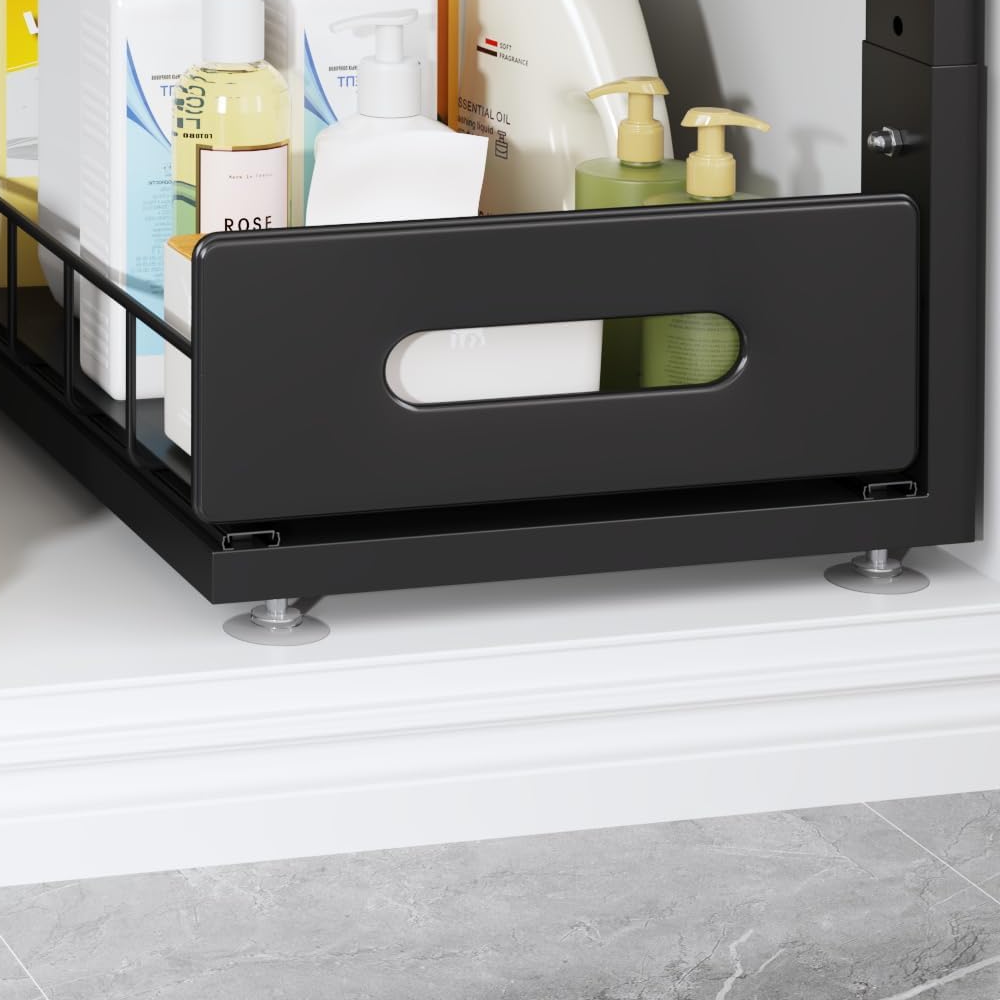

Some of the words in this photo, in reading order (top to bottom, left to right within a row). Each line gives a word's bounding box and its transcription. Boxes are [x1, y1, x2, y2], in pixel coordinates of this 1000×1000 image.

[499, 42, 512, 51] SOFT
[499, 52, 529, 67] FRAGRANCE
[457, 96, 495, 121] SSENTIAL
[496, 111, 511, 126] OIL
[224, 215, 272, 233] ROSE
